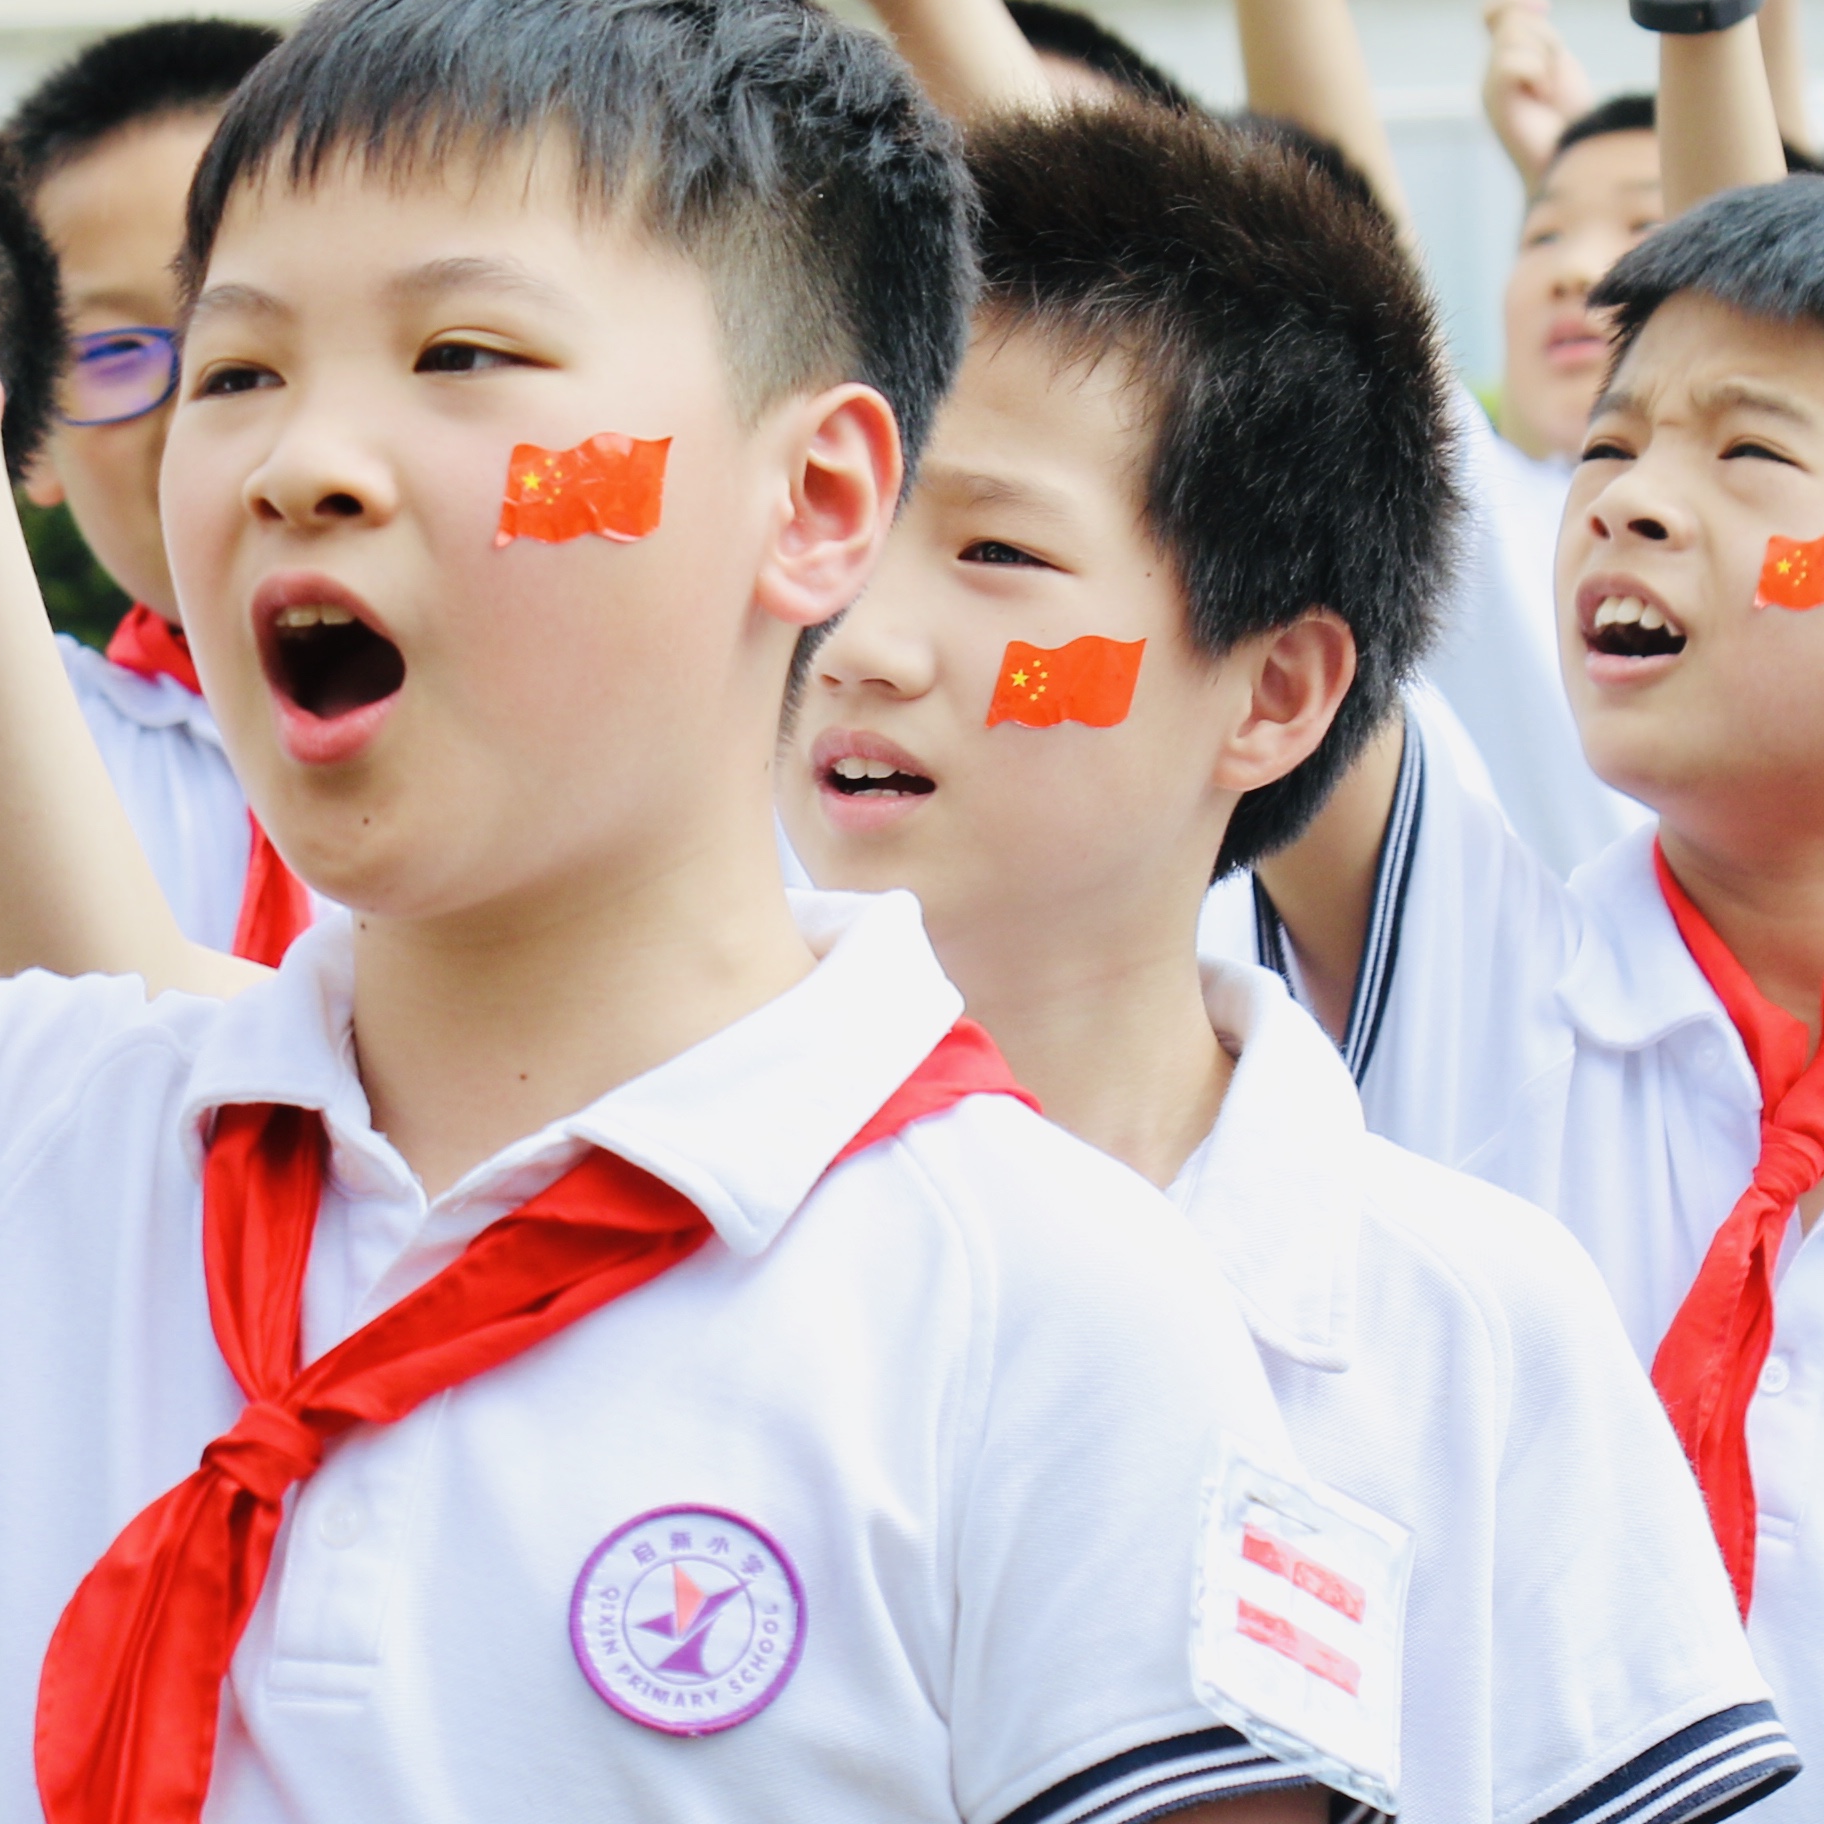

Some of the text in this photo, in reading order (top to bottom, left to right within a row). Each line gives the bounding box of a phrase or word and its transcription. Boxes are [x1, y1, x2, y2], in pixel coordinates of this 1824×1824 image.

[598, 1586, 780, 1708] QIXIN PRIMARY SCHOOL
